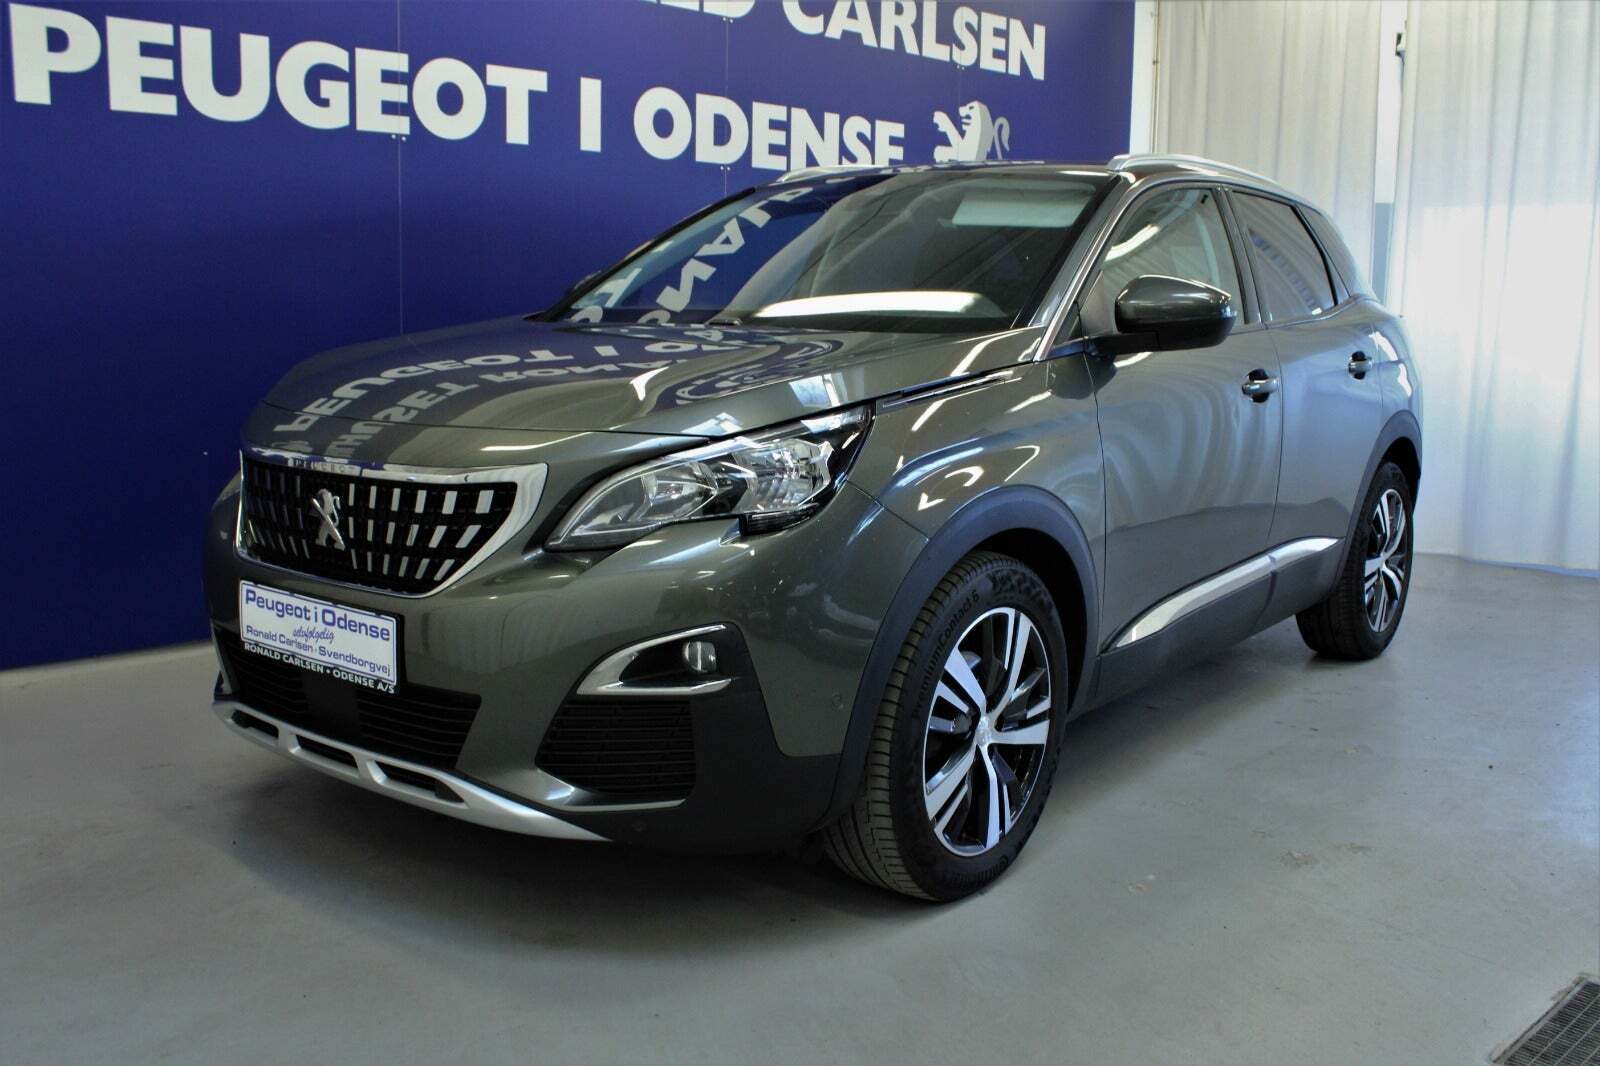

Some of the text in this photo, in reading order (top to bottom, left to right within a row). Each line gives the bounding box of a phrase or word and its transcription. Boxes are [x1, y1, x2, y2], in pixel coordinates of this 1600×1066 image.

[783, 0, 1046, 80] CARLSEN
[9, 3, 905, 171] PEUGEOT I ODENSE
[245, 588, 390, 642] Peugeot i Odense
[244, 642, 395, 694] RONALD CARLSEN ODENSE A/S
[246, 624, 391, 677] Ronald Carlsen Svendborgvej
